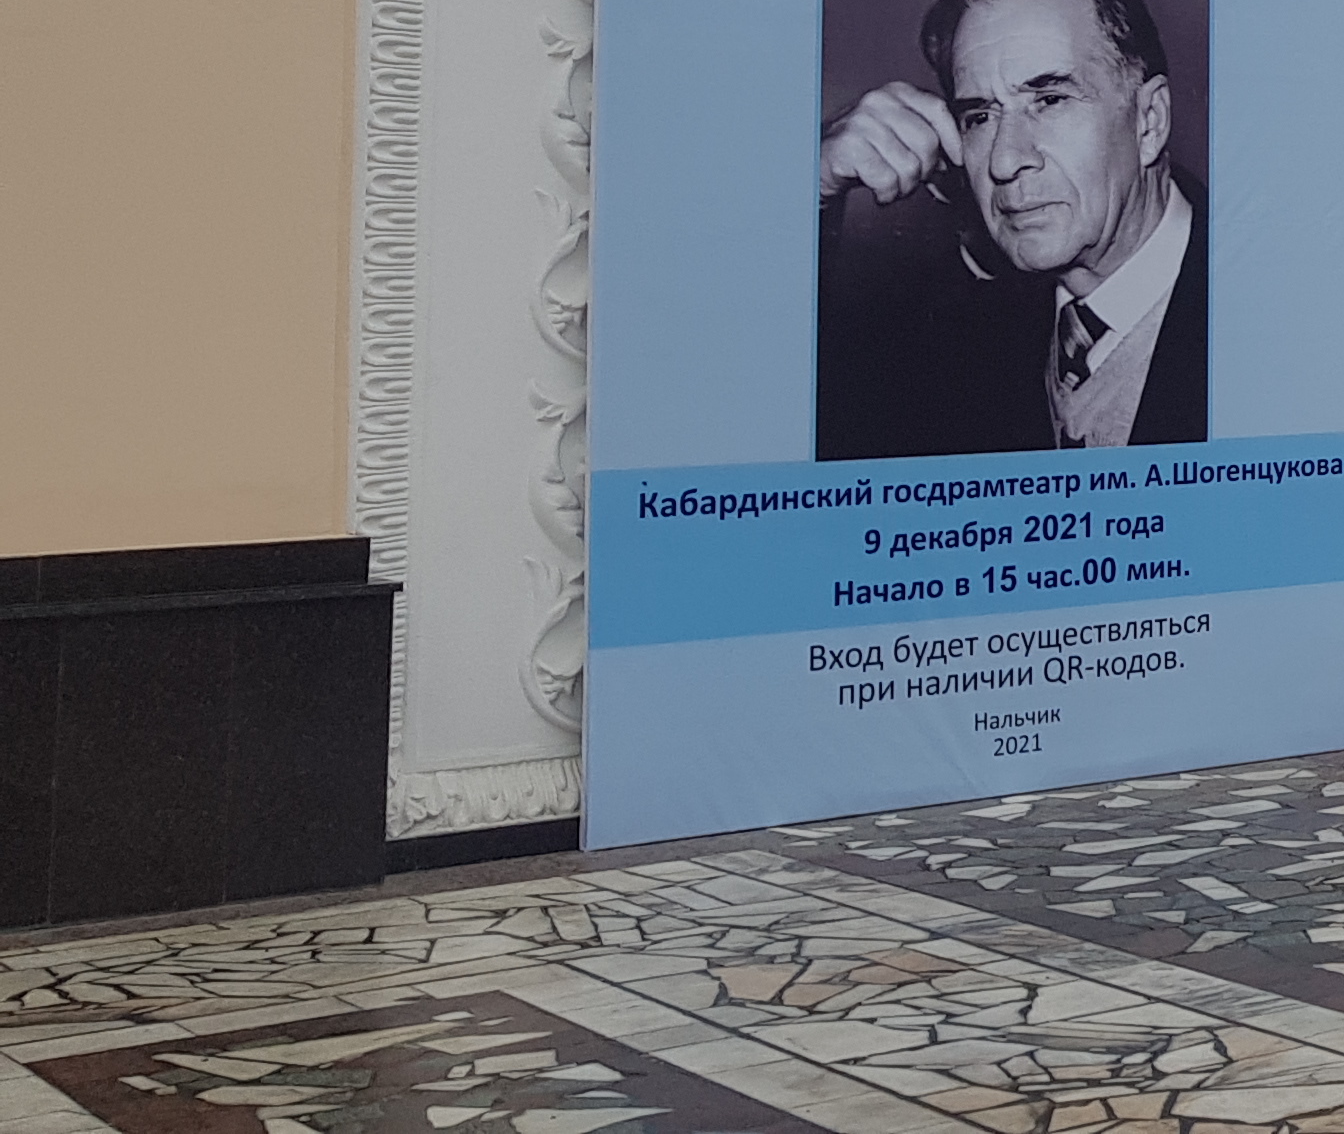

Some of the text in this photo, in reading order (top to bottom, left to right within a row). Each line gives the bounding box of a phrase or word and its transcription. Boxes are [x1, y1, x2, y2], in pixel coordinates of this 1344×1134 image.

[639, 458, 1343, 520] Кабардинский госдрамтеатр им. А.Шогенцукова
[864, 512, 1164, 558] 9 декабря 2021 года
[834, 557, 1190, 606] Начало в 15 час.00 мин.
[810, 613, 1210, 672] Вход будет осуществляться
[839, 650, 1185, 710] при наличии QR-кодов.
[975, 708, 1061, 731] Нальчик
[993, 733, 1042, 757] 2021
